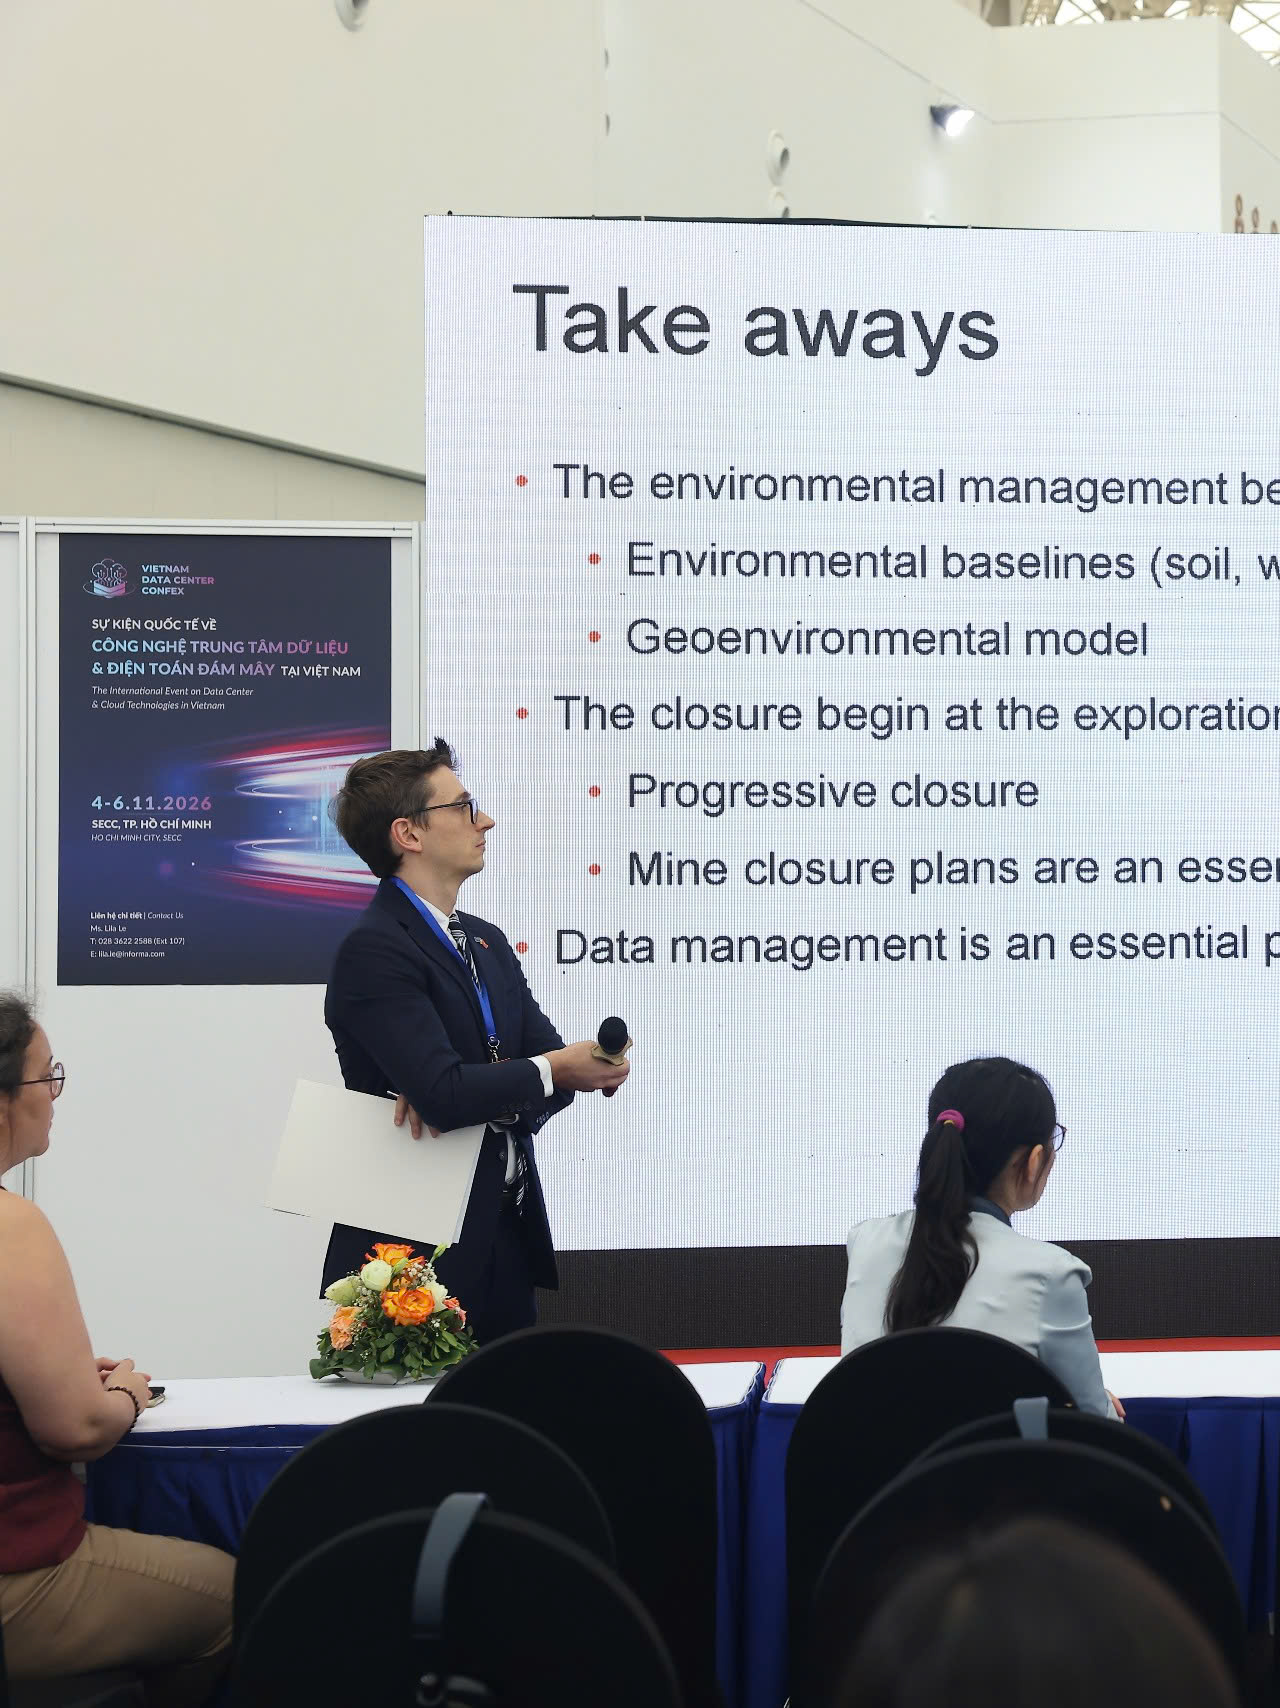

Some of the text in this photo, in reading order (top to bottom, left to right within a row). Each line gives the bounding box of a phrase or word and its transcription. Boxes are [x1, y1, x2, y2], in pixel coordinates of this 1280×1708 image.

[512, 283, 1000, 377] Take aways
[553, 463, 634, 499] The
[650, 467, 944, 503] environmental
[959, 473, 1228, 513] management
[142, 564, 190, 573] VIETNAM
[628, 541, 927, 578] Environmental
[942, 545, 1135, 579] baselines
[1150, 546, 1241, 588] (soil,
[142, 576, 215, 585] DATA CENTER
[142, 587, 184, 595] CONFEX
[92, 617, 217, 631] SỰ KIỆN QUỐC TẾ VỀ
[627, 618, 1147, 656] Geoenvironmental model
[92, 637, 349, 657] CÔNG NGHỆ TRUNG TÂM DỮ LIỆU
[92, 660, 361, 678] & ĐIỆN TOÁN ĐÁM MÂY TẠI VIỆT NAM
[92, 686, 108, 695] The
[109, 686, 163, 695] International
[165, 687, 189, 696] Event
[203, 687, 224, 696] Data
[226, 688, 254, 696] Center
[92, 700, 225, 711] & Cloud Technologies in Vietnam
[553, 695, 635, 730] The
[651, 696, 802, 731] closure
[817, 696, 929, 741] begin
[945, 699, 983, 731] at
[996, 697, 1059, 731] the
[91, 795, 212, 811] 4-6.11.2026
[629, 773, 1039, 818] Progressive closure
[91, 817, 212, 830] SECC, TP. HỒ CHÍ MINH
[120, 834, 141, 842] MINH
[162, 834, 183, 842] SECC
[629, 851, 728, 886] Mine
[745, 851, 895, 885] closure
[910, 850, 1019, 895] plans
[1034, 857, 1099, 884] are
[1114, 857, 1163, 884] an
[107, 912, 116, 920] hệ
[130, 911, 143, 919] tiết
[90, 937, 185, 946] T: 028 3622 2588 (Ext 107)
[556, 929, 655, 965] Data
[671, 928, 947, 971] management
[960, 926, 990, 961] is
[1006, 933, 1055, 961] an
[1069, 924, 1248, 960] essential
[98, 950, 165, 958] lila.le@informa.com
